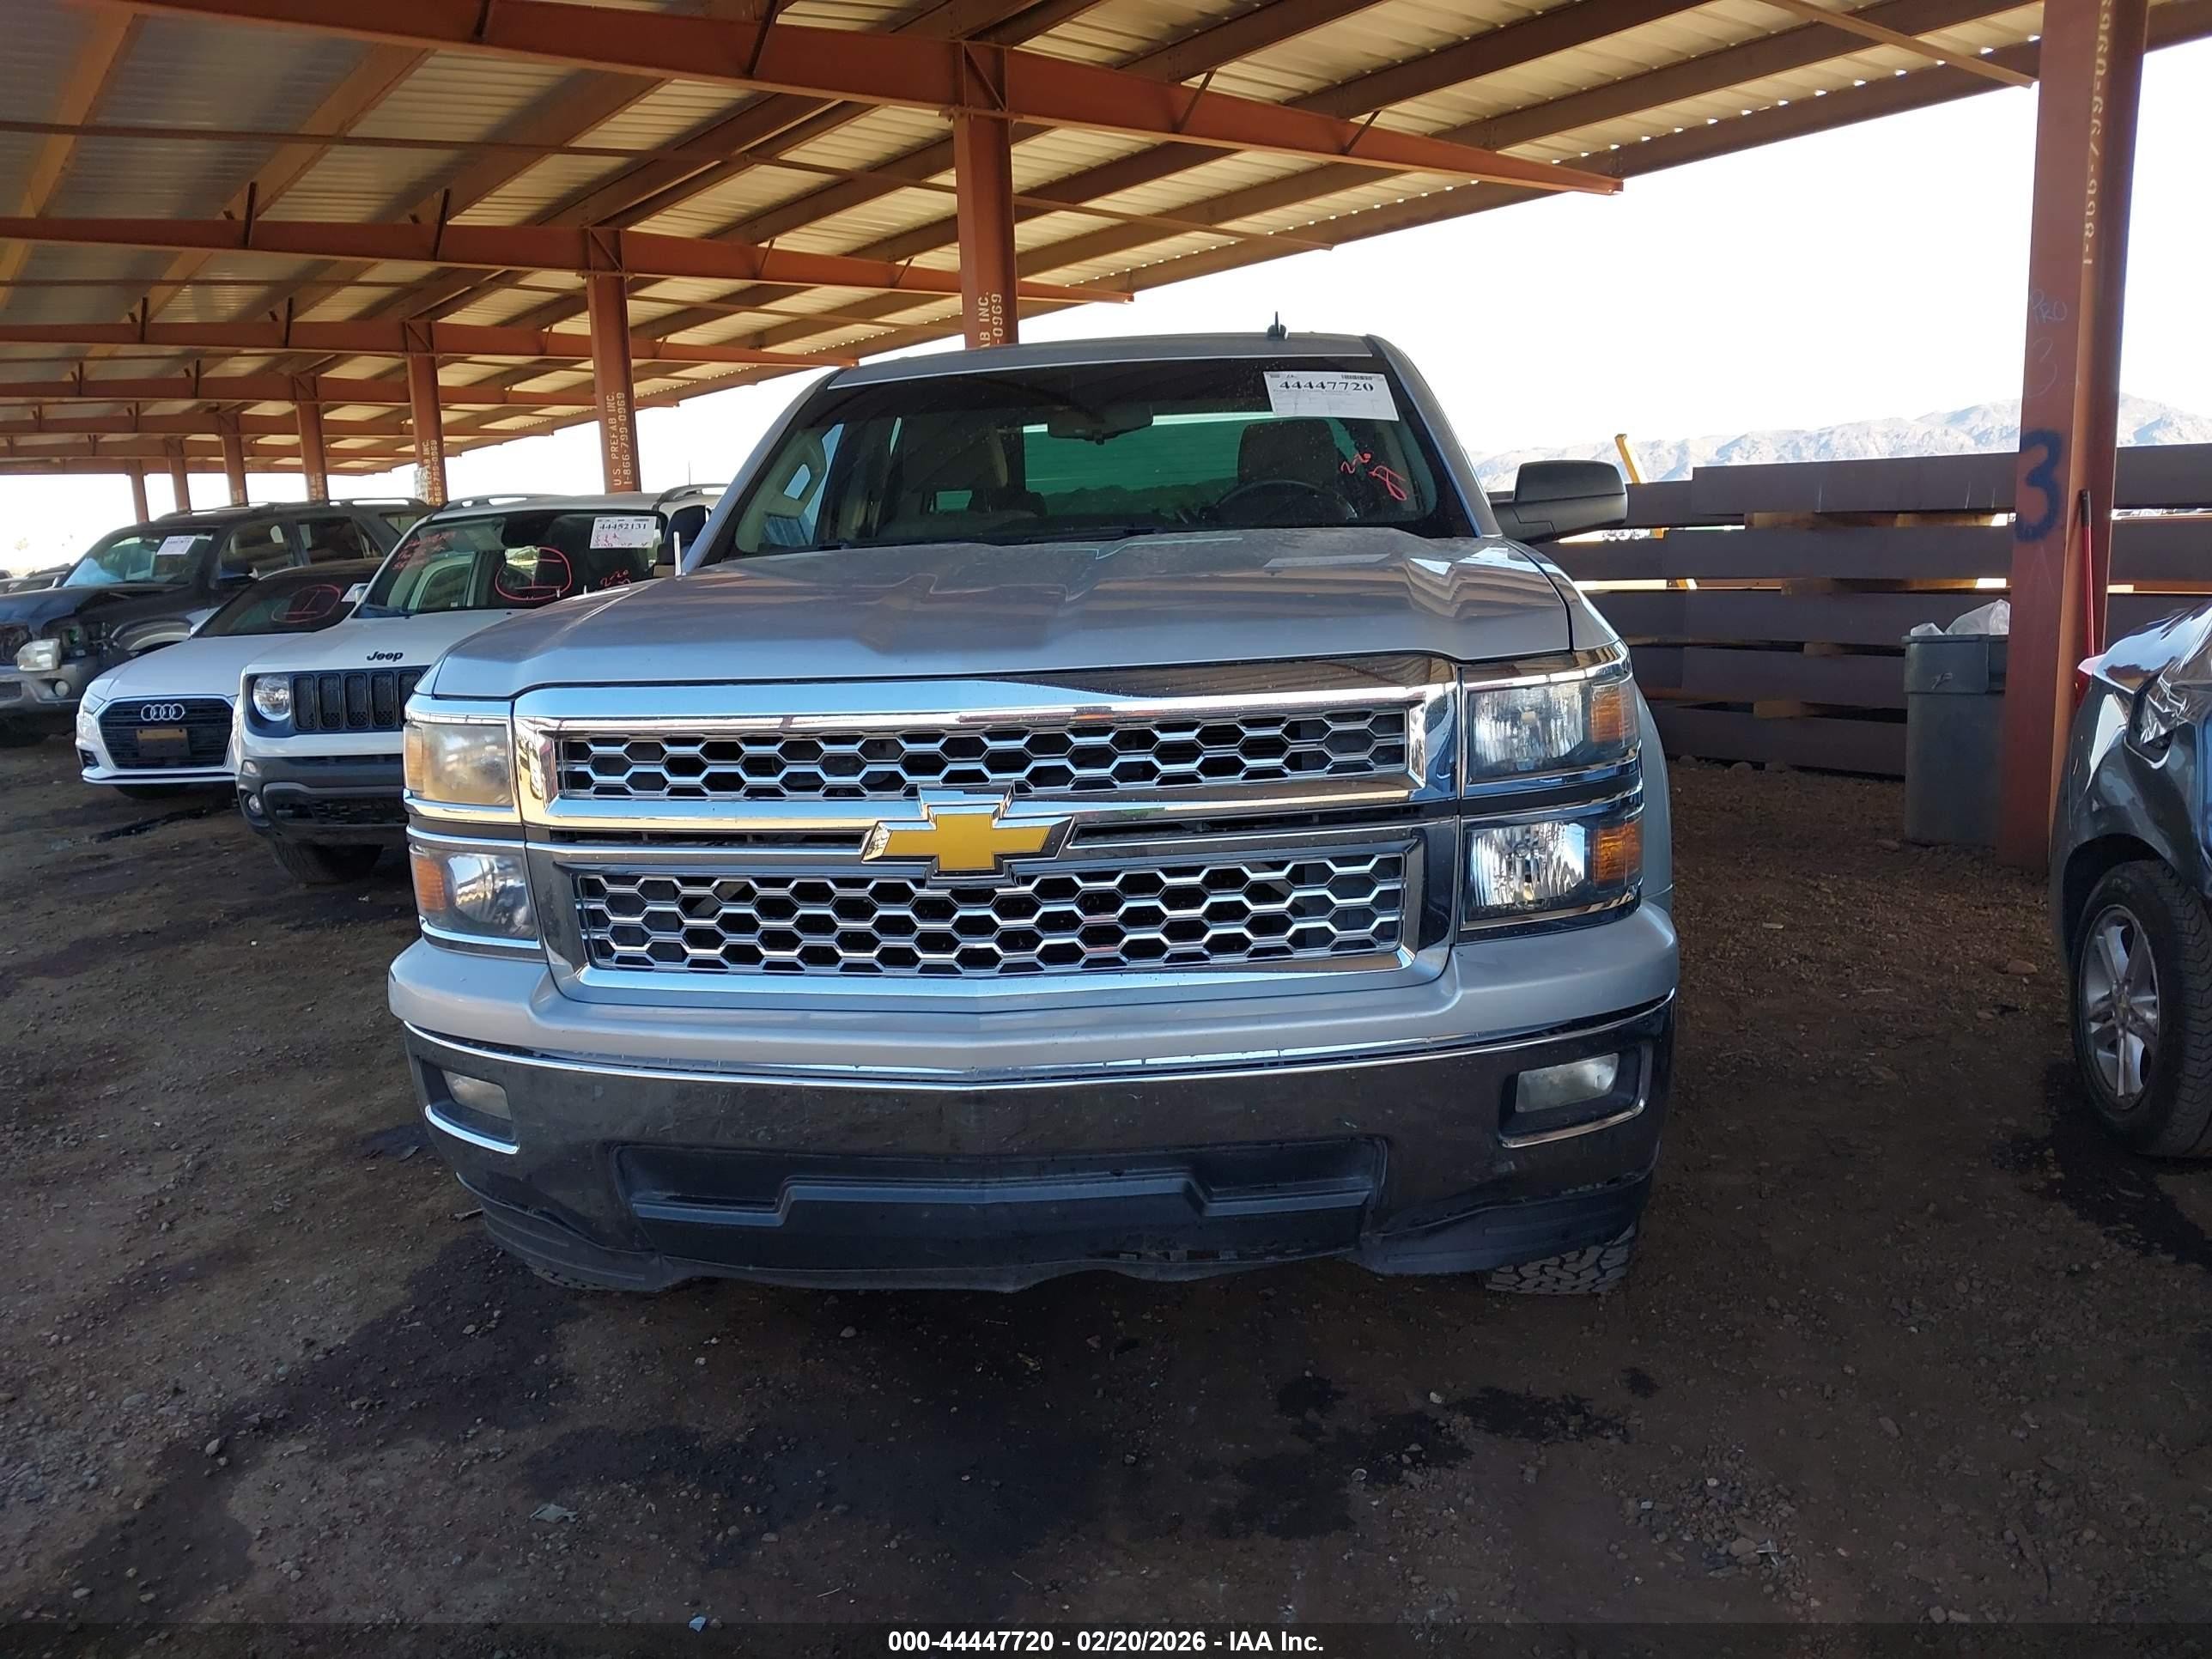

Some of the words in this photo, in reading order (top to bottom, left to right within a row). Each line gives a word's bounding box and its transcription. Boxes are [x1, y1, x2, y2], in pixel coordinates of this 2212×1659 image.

[978, 291, 989, 323] INC.
[1279, 380, 1374, 392] 44447720
[605, 392, 616, 412] INC.
[608, 417, 619, 459] PREFAB
[617, 392, 632, 485] 1-866-799-0969
[612, 465, 622, 486] U.S.
[2015, 429, 2063, 543] 3
[367, 651, 404, 662] Jeep
